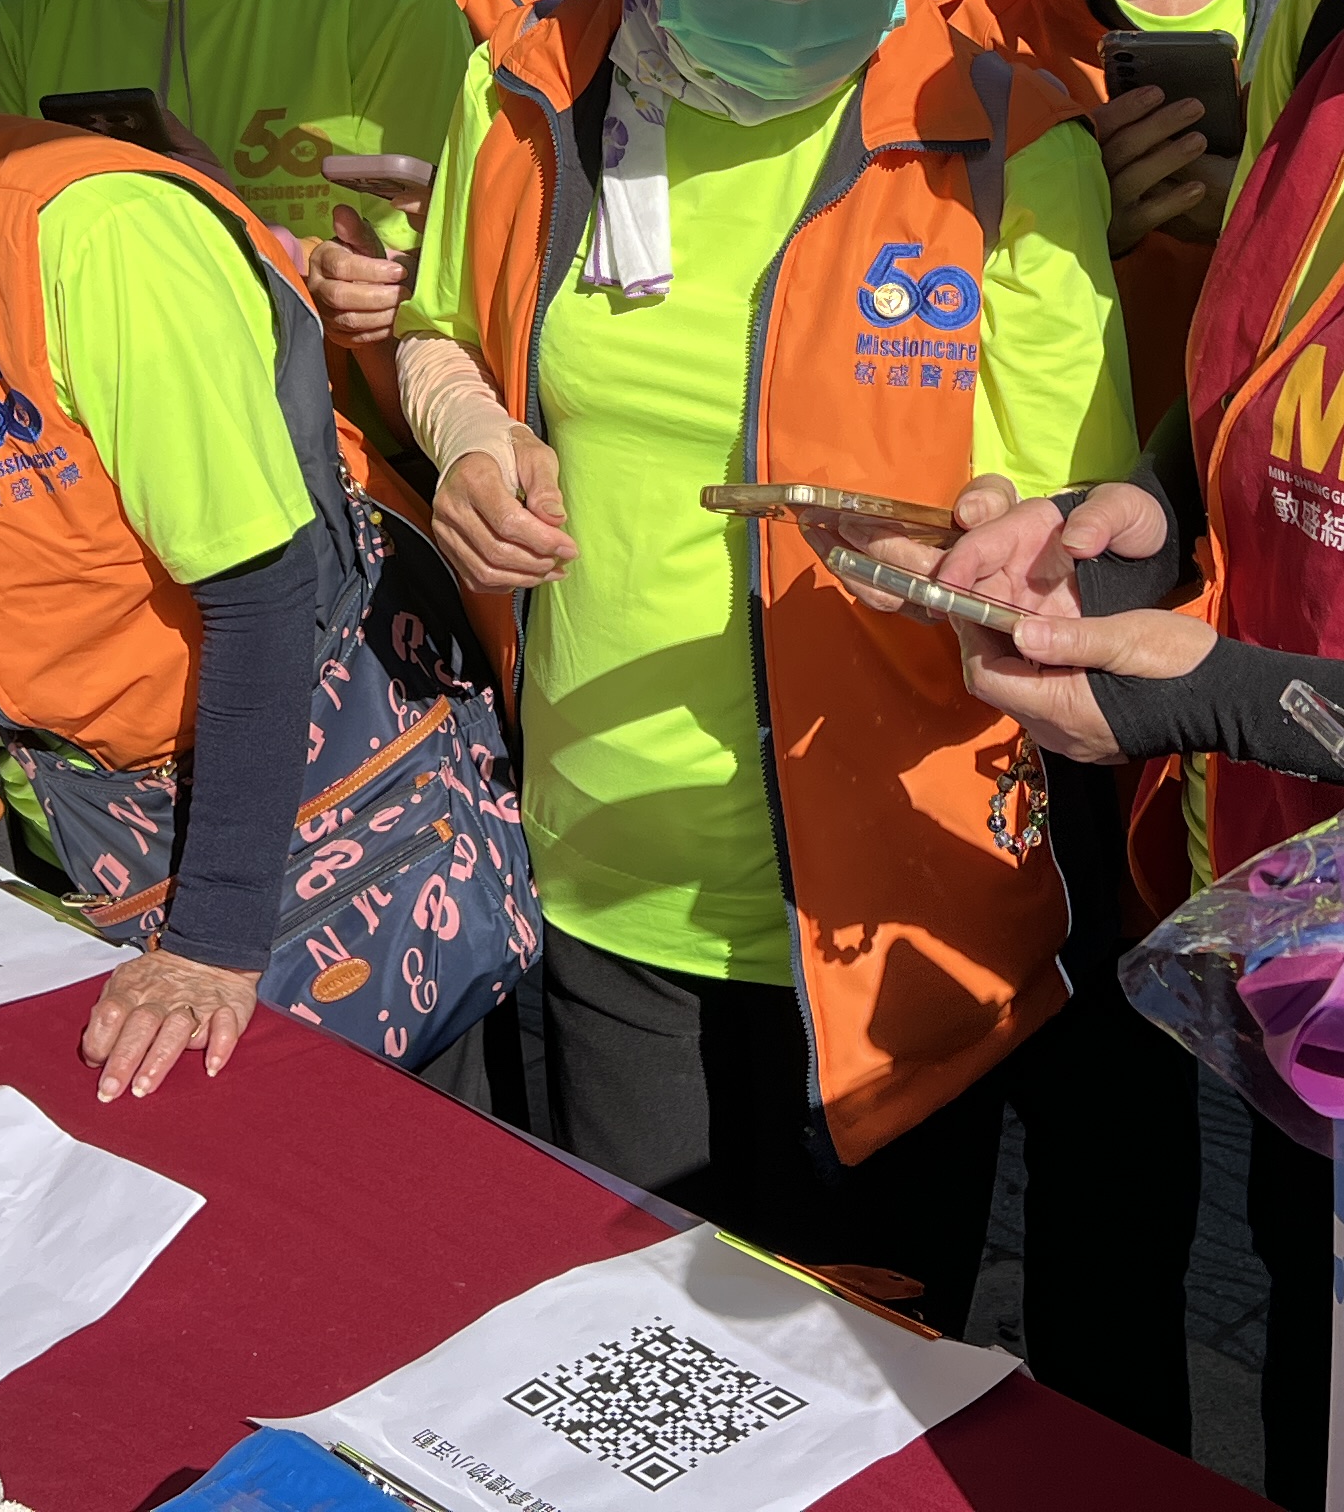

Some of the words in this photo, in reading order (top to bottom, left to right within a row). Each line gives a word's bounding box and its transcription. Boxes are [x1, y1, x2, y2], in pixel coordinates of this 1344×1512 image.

[857, 242, 981, 331] 50
[856, 333, 978, 362] Missioncare
[1268, 465, 1331, 500] MIN-SHENG
